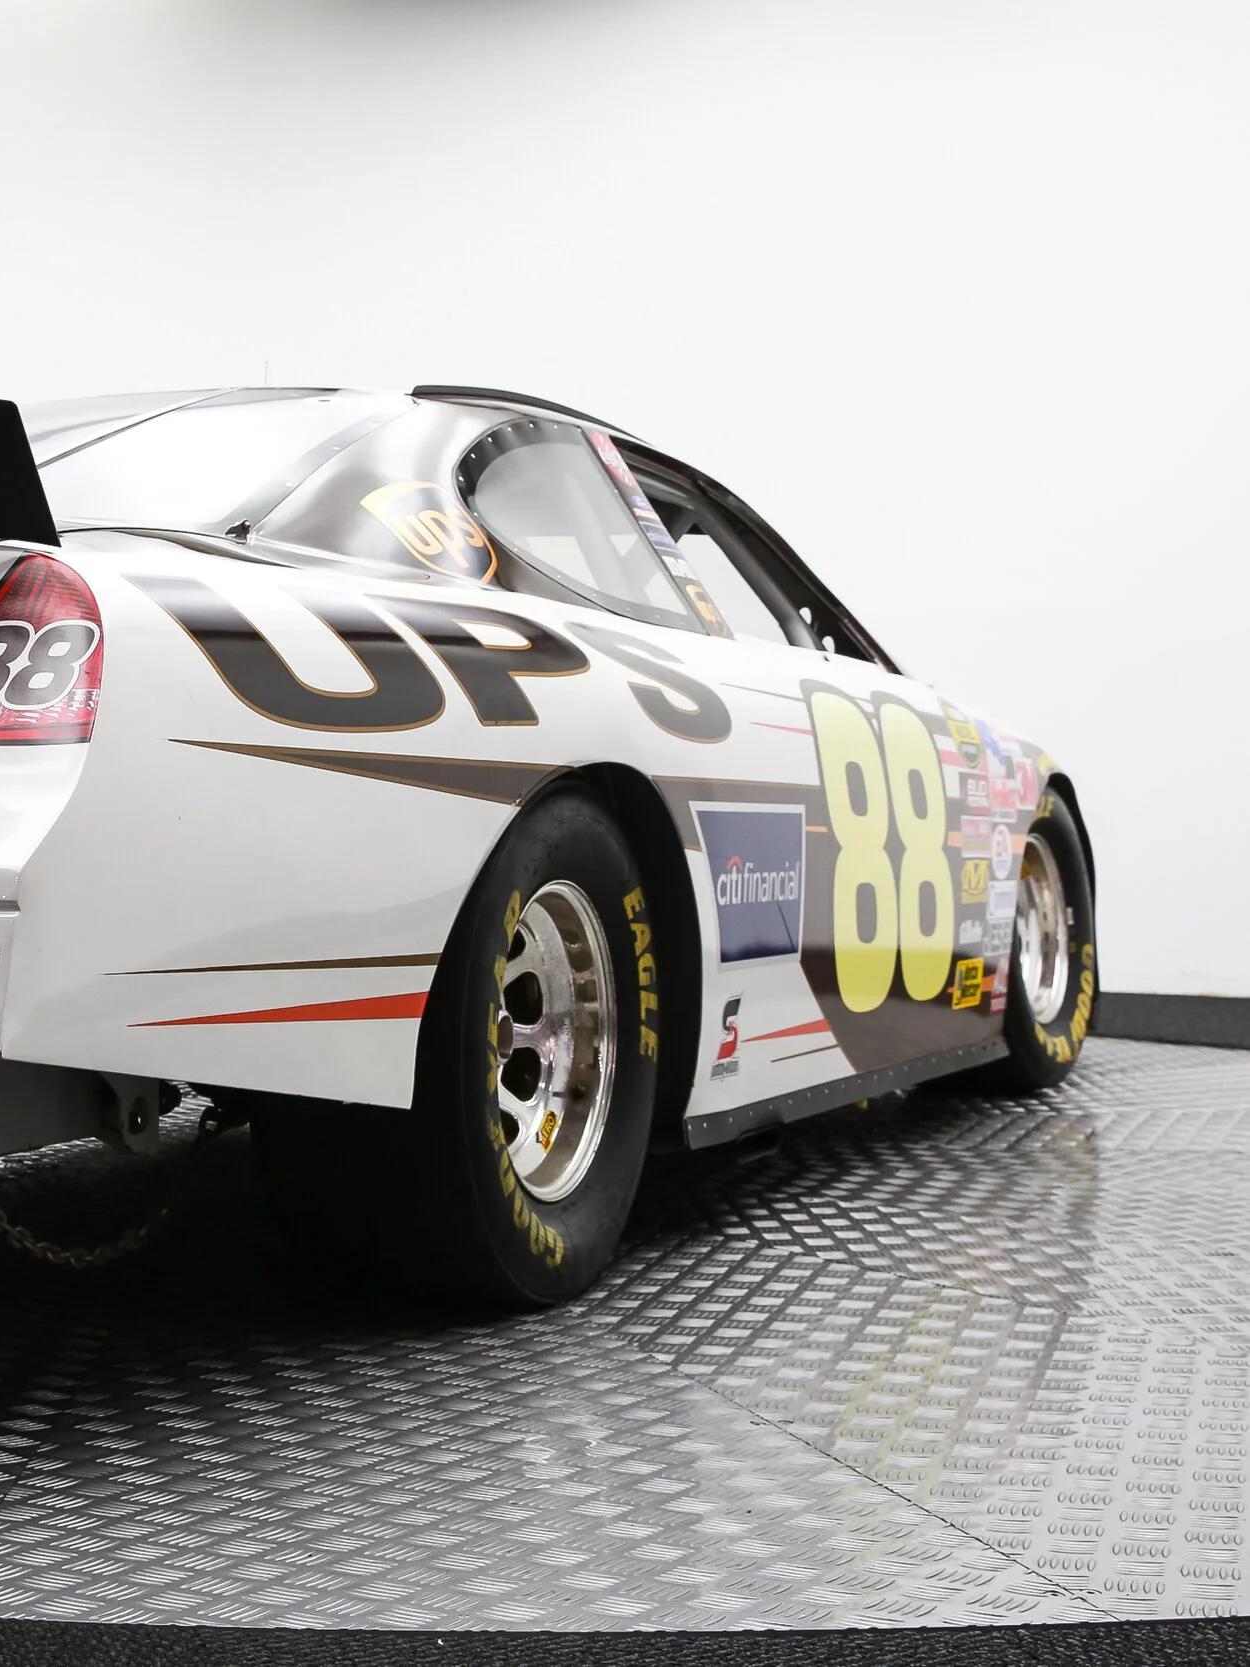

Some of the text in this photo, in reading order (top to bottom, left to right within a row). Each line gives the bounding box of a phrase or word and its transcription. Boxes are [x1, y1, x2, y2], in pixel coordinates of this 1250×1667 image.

[397, 508, 485, 568] ups
[123, 573, 732, 744] UPS
[716, 857, 800, 905] citifinancial
[802, 682, 955, 1013] 88
[623, 885, 659, 1063] EAGLE
